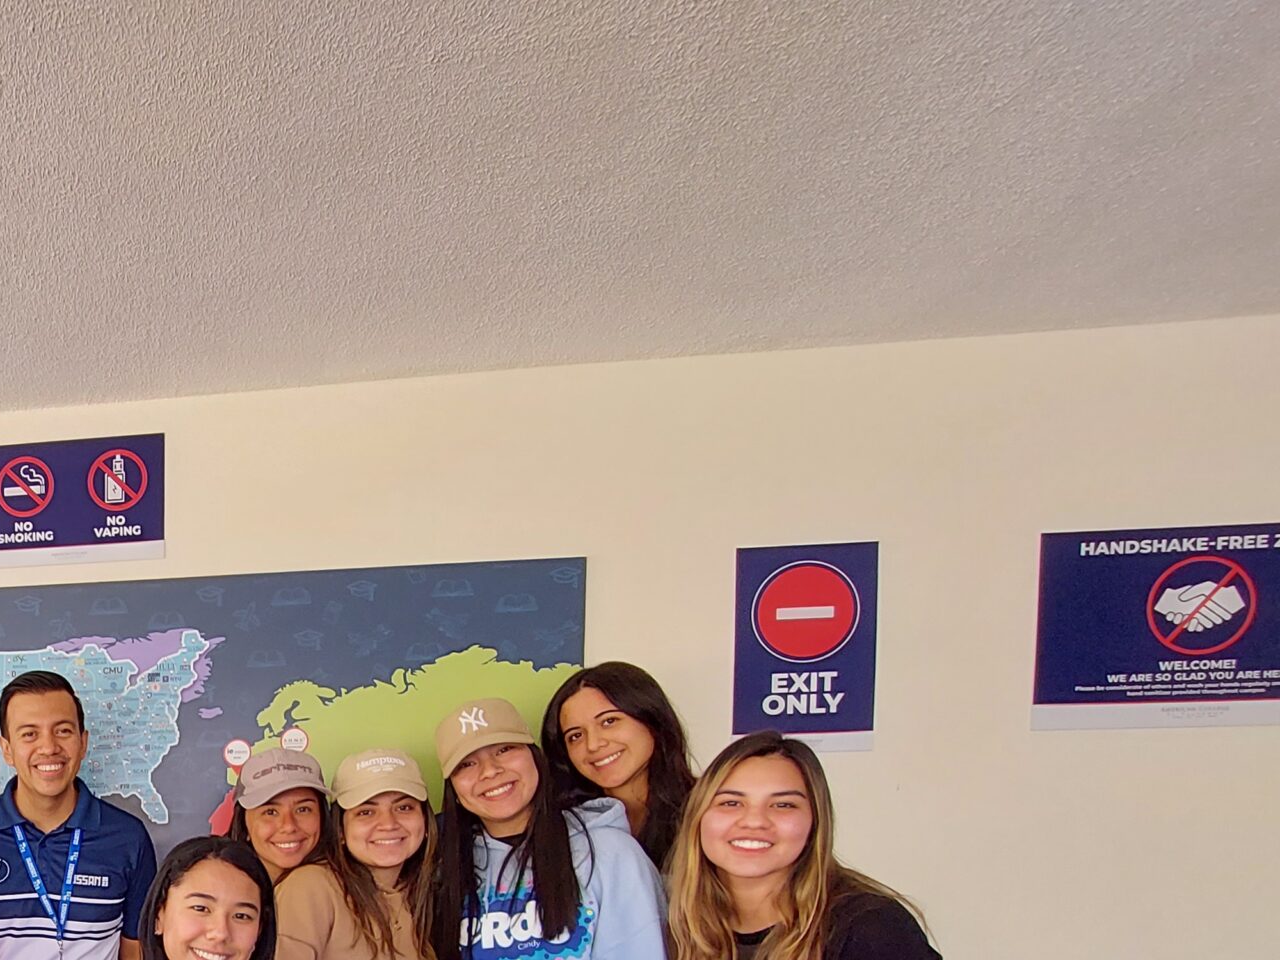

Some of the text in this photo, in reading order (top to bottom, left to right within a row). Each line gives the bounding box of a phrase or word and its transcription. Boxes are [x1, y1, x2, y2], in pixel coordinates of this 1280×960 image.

[14, 521, 34, 532] NO
[106, 515, 126, 526] NO
[93, 525, 142, 538] VAPING
[1080, 534, 1269, 556] HANDSHAKE-FREE
[103, 666, 123, 675] CMU
[1158, 659, 1237, 671] WELCOME!
[771, 671, 838, 694] EXIT
[1107, 674, 1127, 683] WE
[1129, 673, 1153, 682] ARE
[1155, 673, 1172, 682] SO
[1173, 672, 1206, 681] GLAD
[1209, 671, 1234, 680] YOU
[1236, 670, 1261, 679] ARE
[762, 693, 845, 715] ONLY
[458, 706, 489, 735] NY
